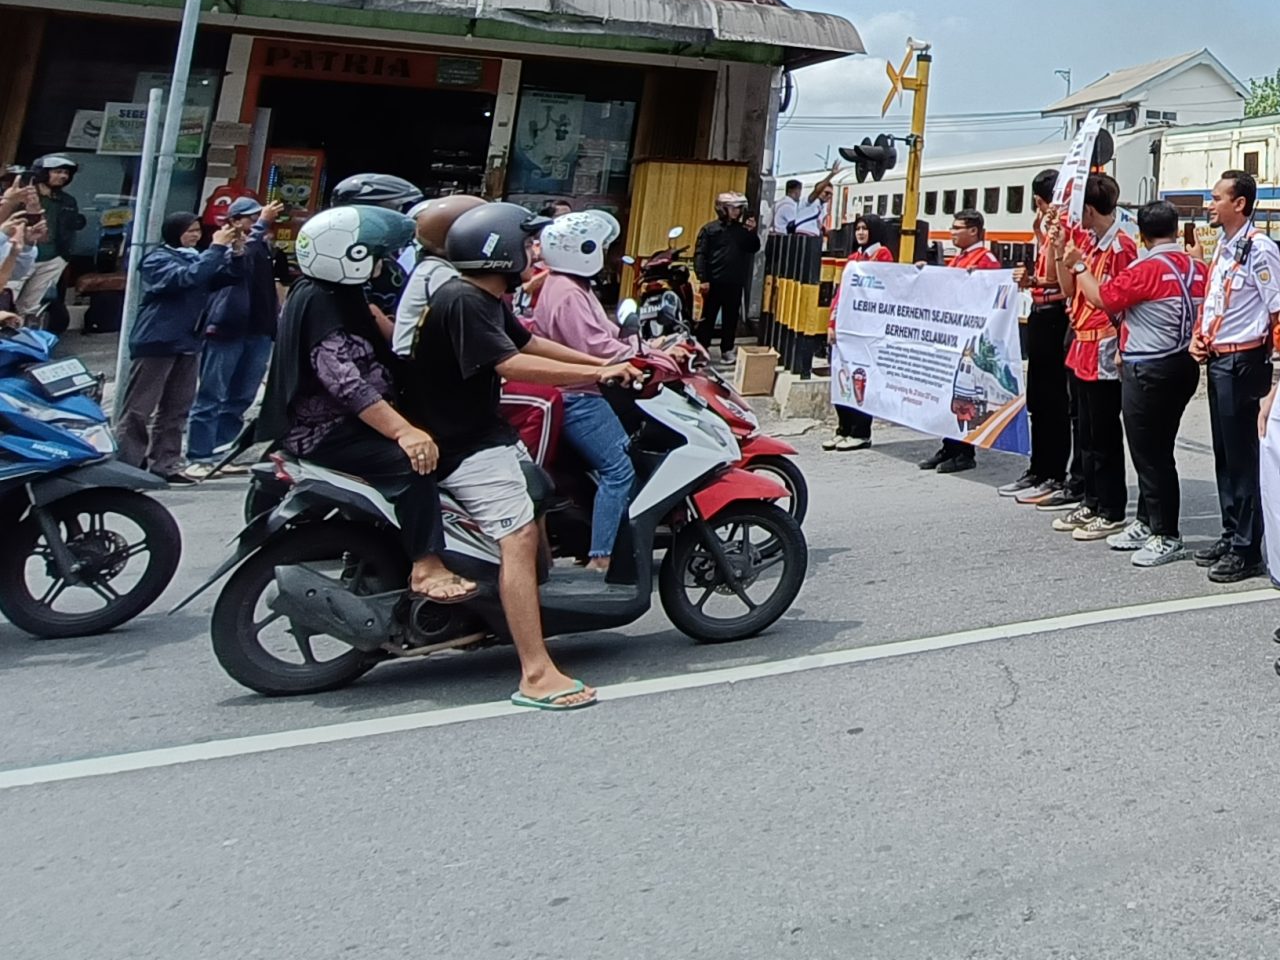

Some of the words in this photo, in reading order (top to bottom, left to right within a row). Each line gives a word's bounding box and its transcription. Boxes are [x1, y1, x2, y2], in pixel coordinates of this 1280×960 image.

[264, 47, 411, 78] PATRIA
[853, 299, 877, 313] LEBIH
[879, 303, 896, 317] BAIK
[897, 305, 930, 320] BERHENTI
[932, 309, 964, 327] SEJENAK
[885, 324, 920, 340] BERHENTI
